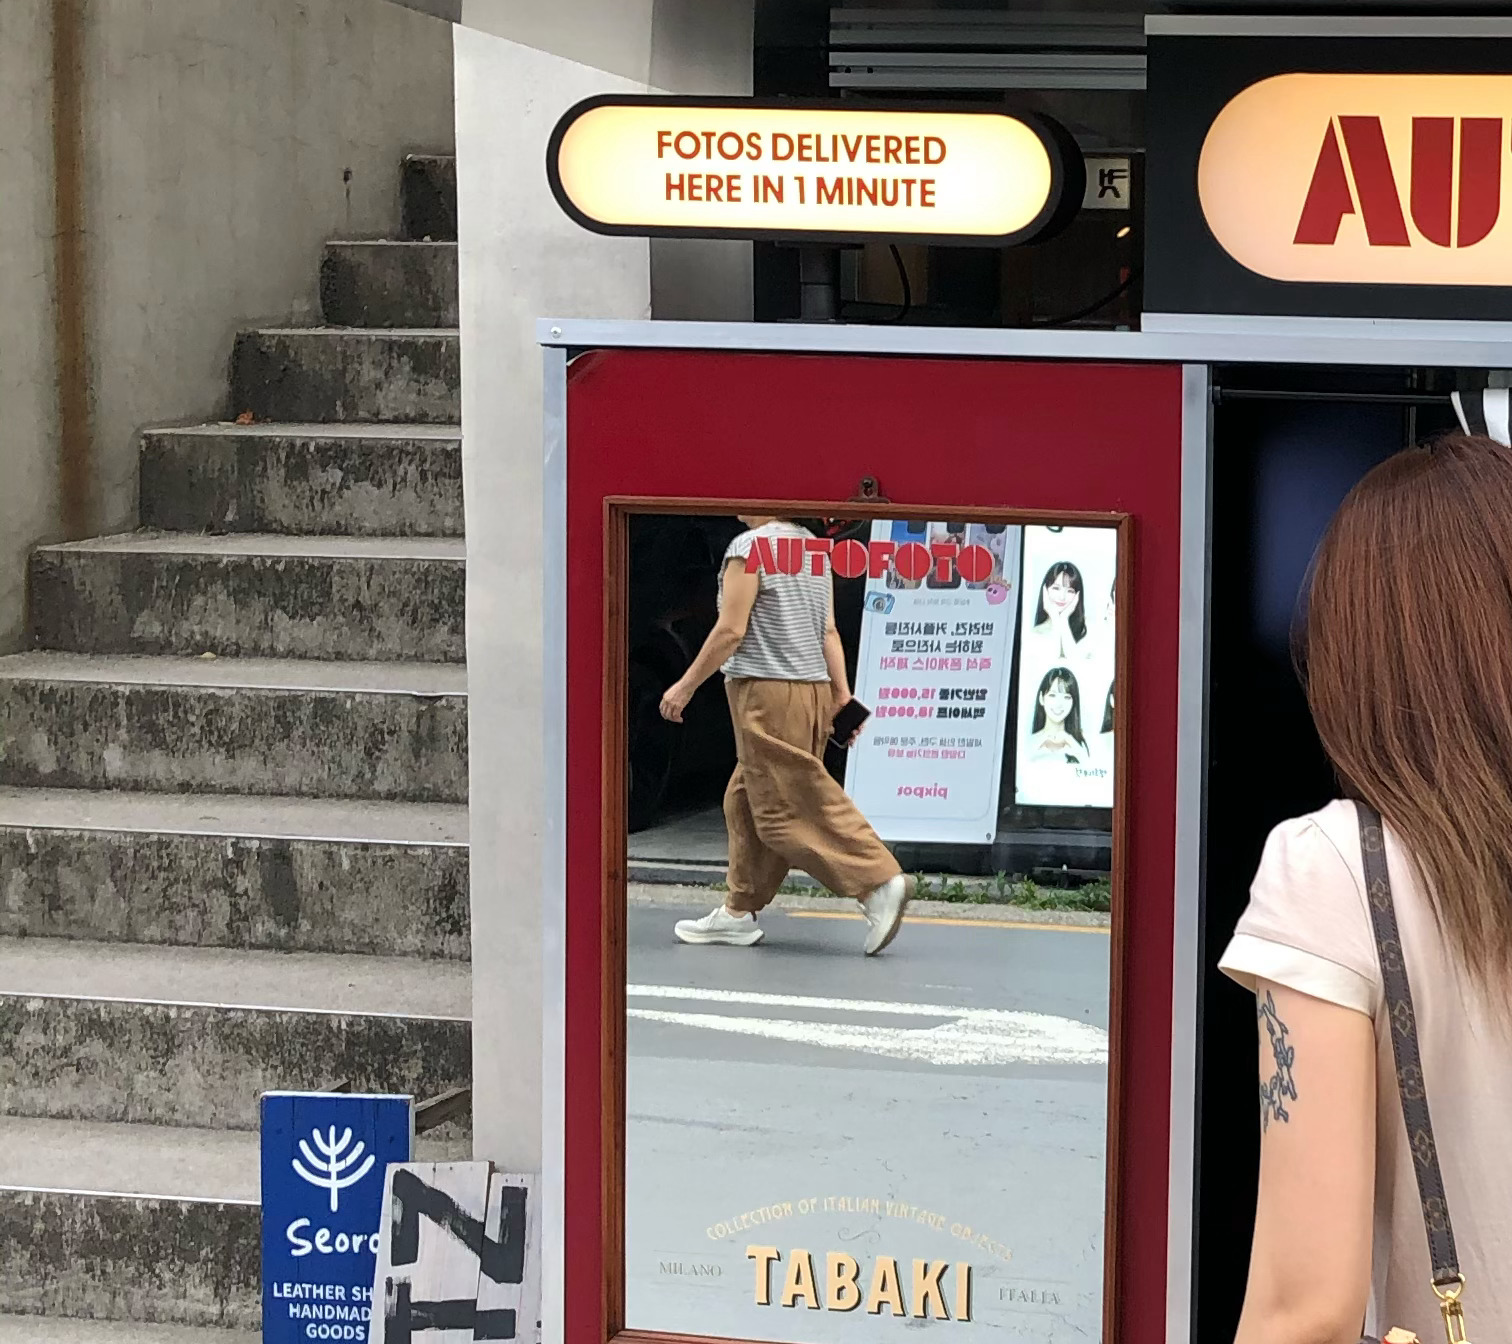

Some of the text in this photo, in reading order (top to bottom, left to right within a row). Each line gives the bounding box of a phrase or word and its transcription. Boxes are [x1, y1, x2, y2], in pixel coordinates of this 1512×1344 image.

[656, 130, 947, 166] FOTOS DELIVERED
[664, 173, 936, 208] HERE IN 1 MINUTE
[743, 536, 994, 584] AUTOFOTO
[706, 1202, 794, 1241] COLLECTION
[798, 1197, 818, 1215] OF
[824, 1196, 880, 1215] ITALIAN
[659, 1261, 723, 1278] MILANO
[745, 1244, 975, 1323] TABAKI
[273, 1281, 374, 1302] LEATHER SH
[998, 1288, 1062, 1305] ITALIA
[288, 1302, 372, 1322] HANDMAD
[305, 1323, 366, 1341] GOODS
